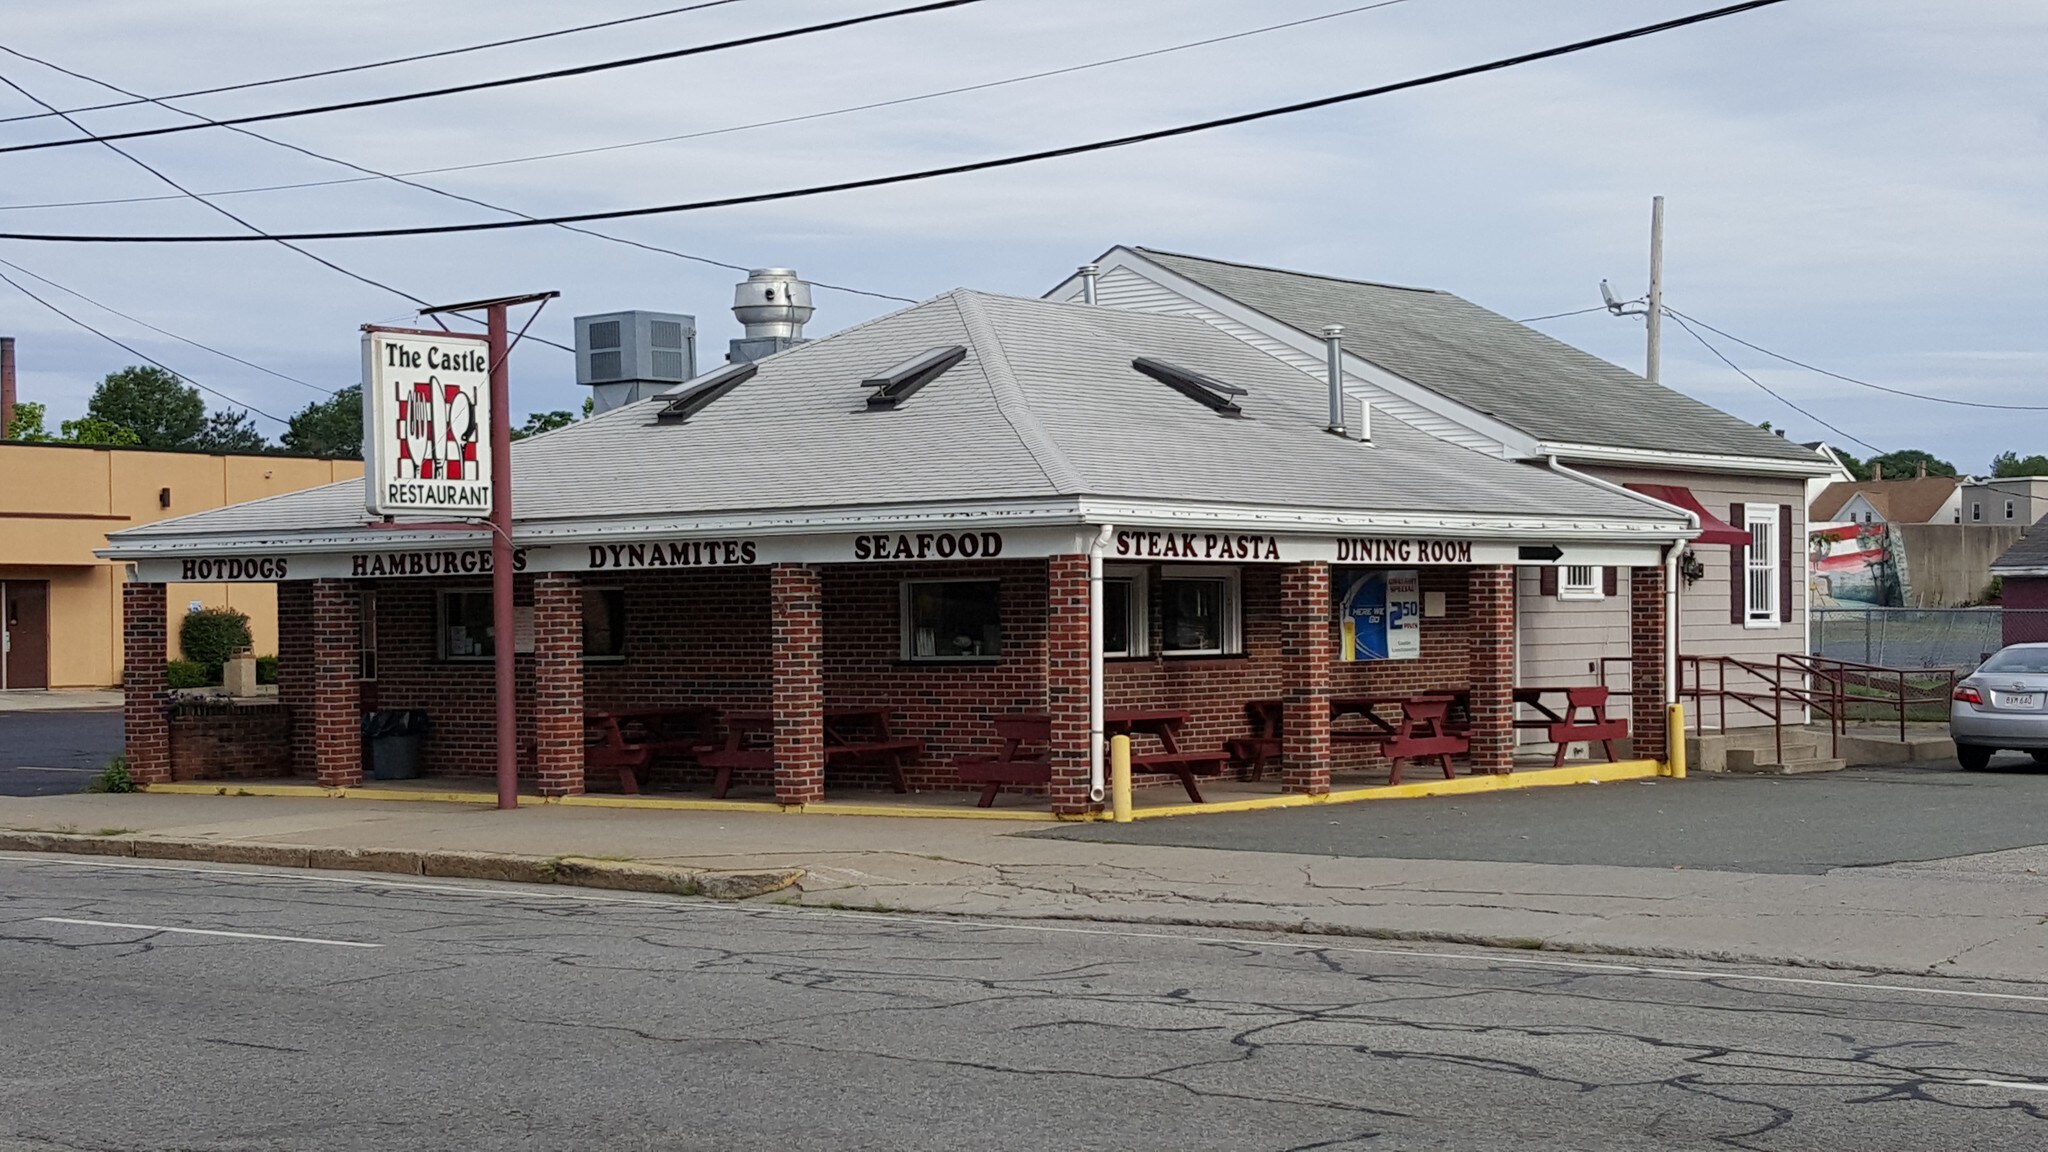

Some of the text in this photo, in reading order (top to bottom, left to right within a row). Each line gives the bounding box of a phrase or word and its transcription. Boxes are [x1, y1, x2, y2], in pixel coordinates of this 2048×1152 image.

[386, 343, 486, 373] The Castle
[388, 484, 489, 506] RESTAURANT
[588, 540, 757, 568] DYNAMITES
[854, 532, 1003, 560] SEAFOOD
[1116, 531, 1280, 560] STEAK PASTA
[1336, 538, 1473, 563] DINING ROOM
[182, 558, 288, 579] HOTDOGS
[351, 550, 527, 576] HAMBURGES
